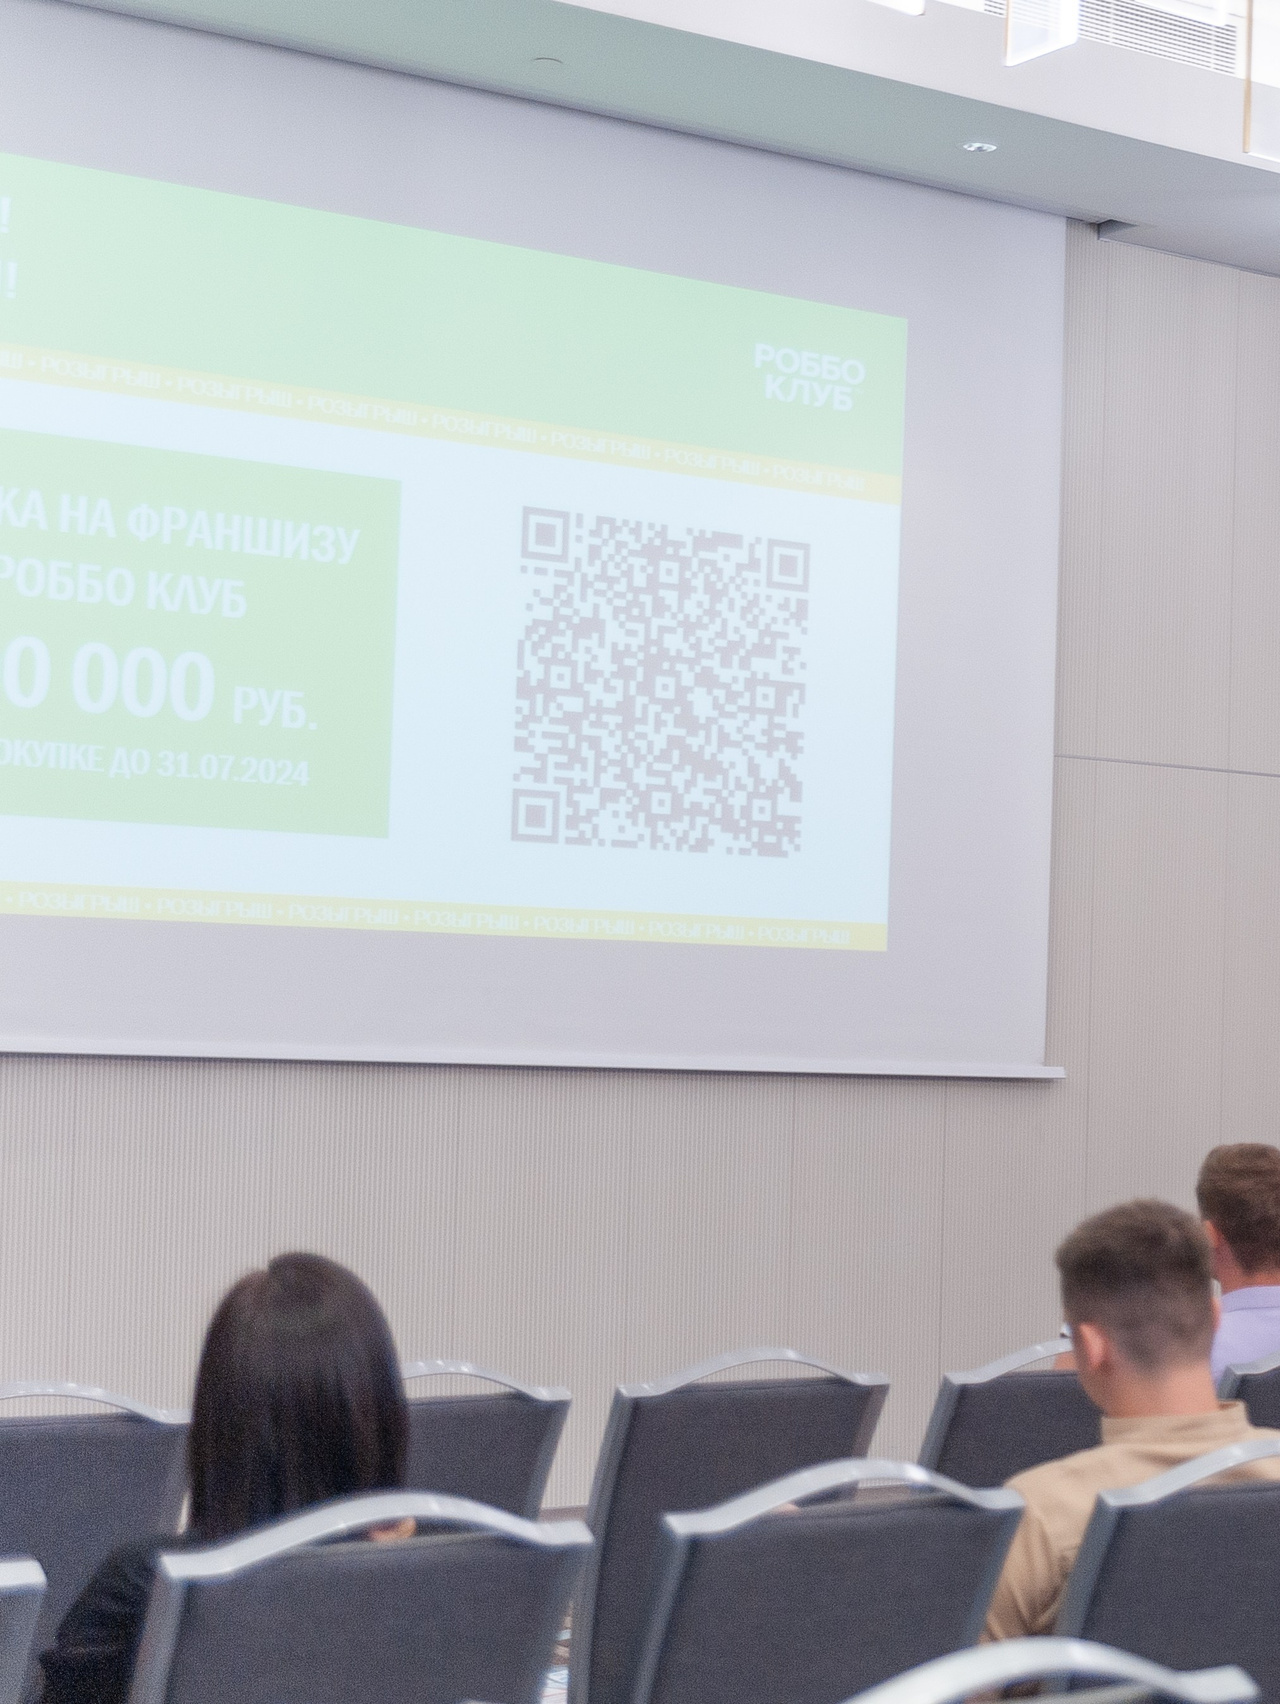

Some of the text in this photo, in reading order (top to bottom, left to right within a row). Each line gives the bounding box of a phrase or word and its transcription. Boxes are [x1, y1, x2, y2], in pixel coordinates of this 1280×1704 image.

[754, 342, 866, 385] РОББО
[765, 374, 854, 412] КЛУБ
[41, 356, 160, 390] РОЗЫГРЫШ
[178, 377, 292, 410] РОЗЫГРЫШ
[308, 396, 418, 427] РОЗЫГРЫШ
[432, 413, 537, 443] РОЗЫГРЫШ
[551, 432, 651, 460] РОЗЫГРЫШ
[665, 449, 761, 476] РОЗЫГРЫШ
[773, 464, 865, 492] РОЗЫГРЫШ
[60, 494, 117, 538] НА
[127, 503, 361, 565] ФРАНШИЗУ
[0, 554, 247, 619] РОББО КЛУБ
[4, 635, 318, 730] 0 000 РУБ.
[108, 748, 151, 779] ДО
[157, 750, 310, 787] 31.07.2024
[20, 891, 850, 945] РОЗЫГРЫШ РОЗЫГРЫШ РОЗЫГРЫШ РОЗЫГРЫШ РОЗЫГРЫШ РОЗЫГРЫШ РОЗЫГРЫШ
